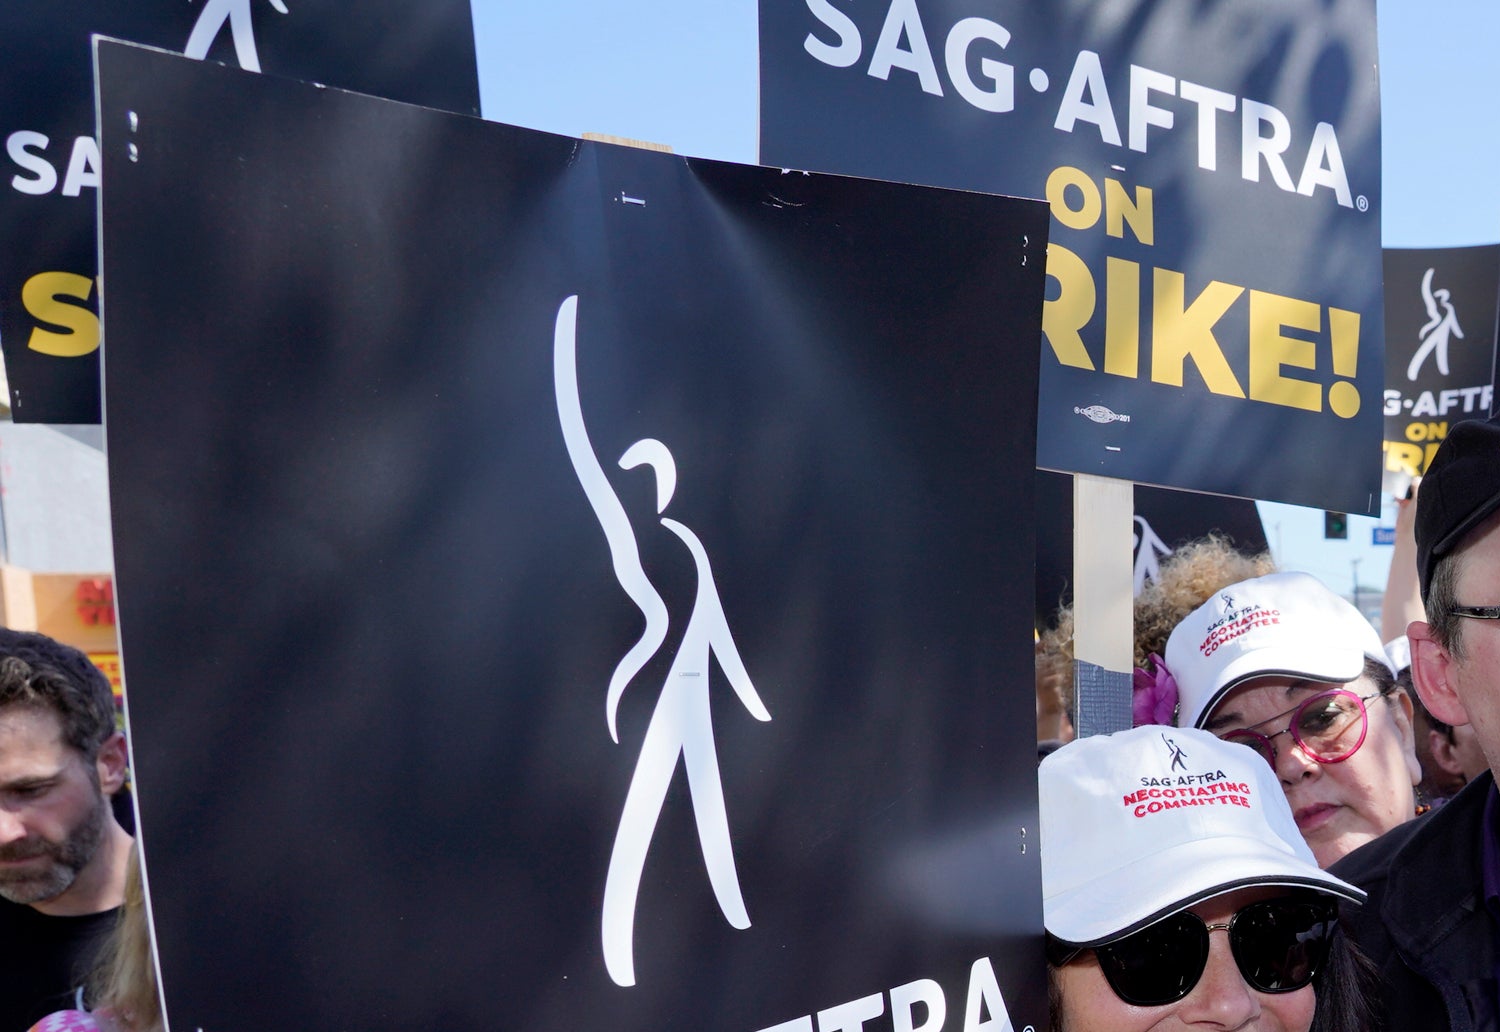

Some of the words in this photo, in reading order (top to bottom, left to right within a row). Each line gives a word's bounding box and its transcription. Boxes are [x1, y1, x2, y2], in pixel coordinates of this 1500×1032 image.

[1045, 166, 1154, 246] ON
[21, 271, 102, 358] S
[1405, 421, 1448, 442] ON
[1199, 609, 1280, 652] NEGOTIATING
[1204, 617, 1280, 657] COMMITTEE
[1123, 782, 1251, 806] NEGOTIATING
[1133, 794, 1251, 818] COMMITTEE
